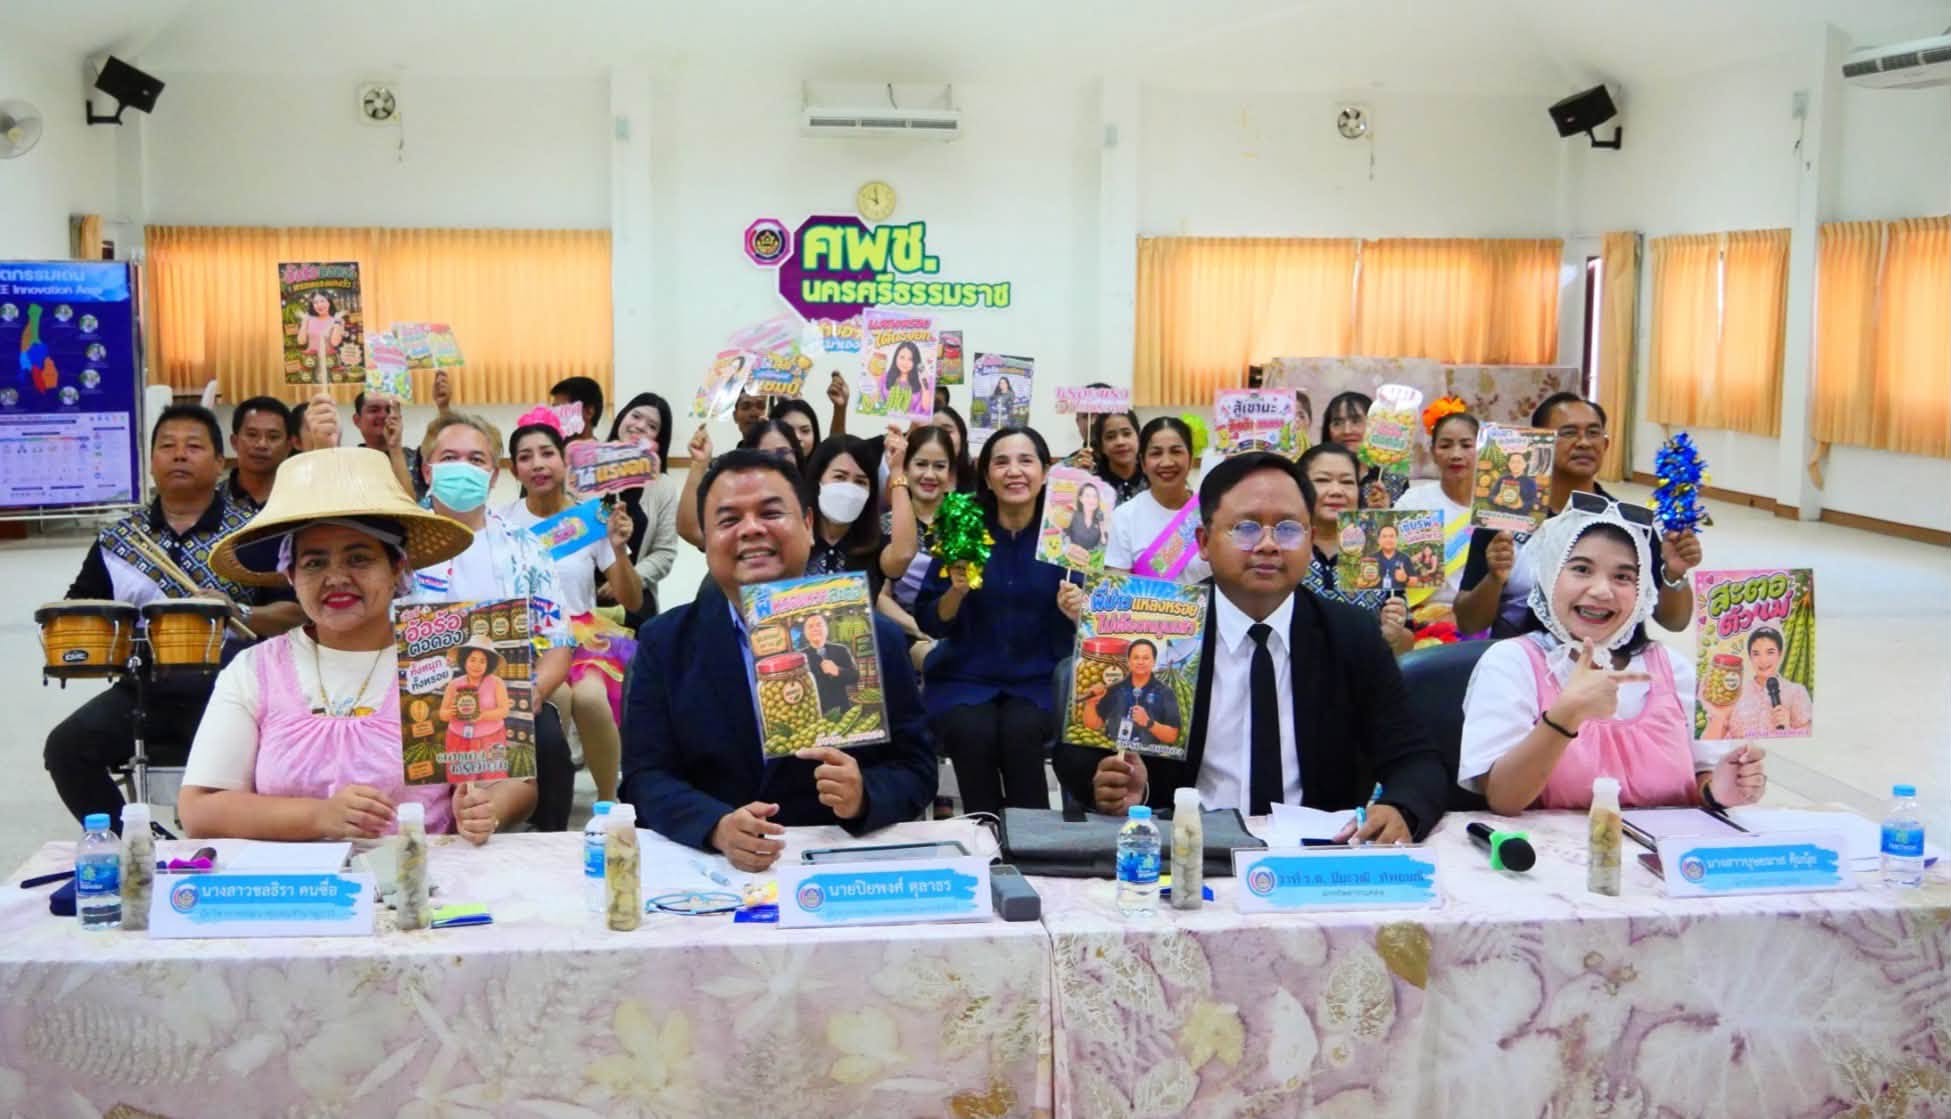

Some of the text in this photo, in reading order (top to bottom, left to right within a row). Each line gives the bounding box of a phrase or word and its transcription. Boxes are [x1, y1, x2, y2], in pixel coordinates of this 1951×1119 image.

[803, 223, 939, 273] ศพช.
[13, 284, 73, 295] Innovation
[802, 272, 1010, 307] นครศรีธรรมราช
[1132, 596, 1199, 618] แหลงหรอย
[1709, 574, 1788, 617] สะตอ
[406, 610, 461, 642] อ้อร้อ
[1718, 590, 1793, 638] ตัวแม่
